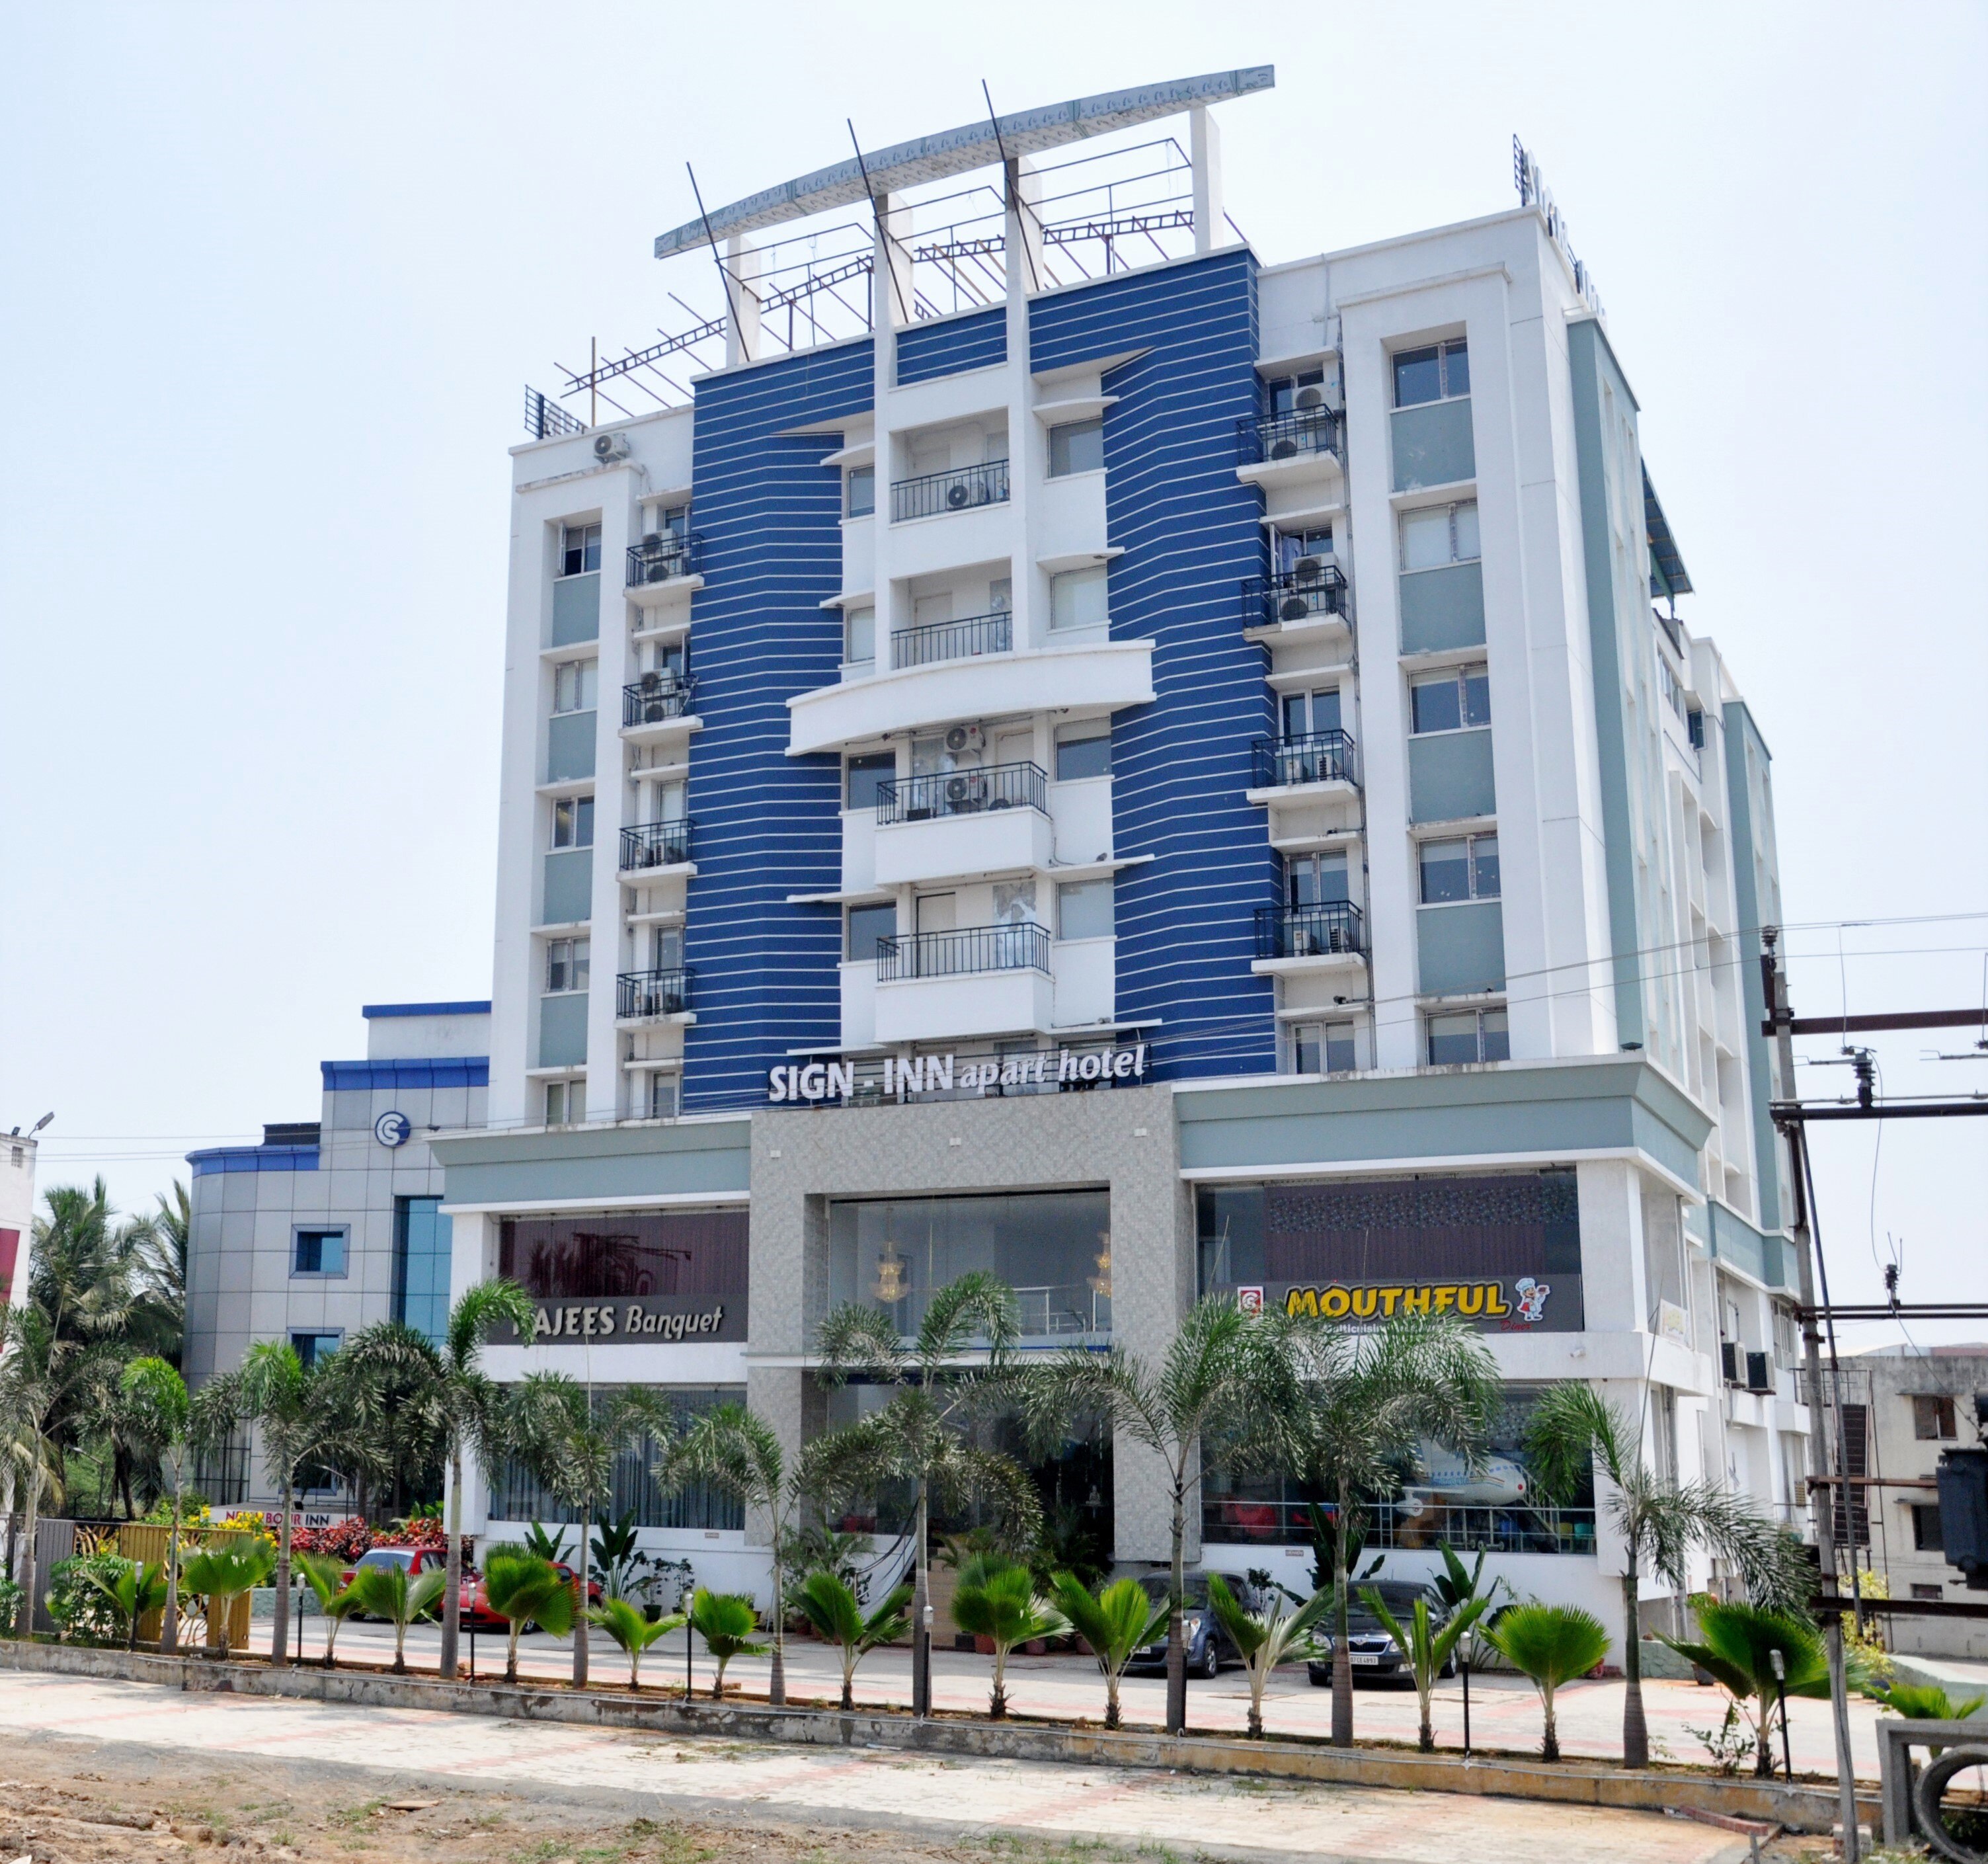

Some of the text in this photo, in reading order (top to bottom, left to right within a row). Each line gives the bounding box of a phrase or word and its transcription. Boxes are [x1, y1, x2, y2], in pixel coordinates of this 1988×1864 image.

[769, 1061, 854, 1102] SIGN
[884, 1054, 953, 1094] INN
[960, 1051, 1047, 1094] apart
[1058, 1044, 1145, 1082] hotel
[1287, 1285, 1507, 1317] MOUTHFUL
[512, 1305, 723, 1340] AJEES Banquet
[305, 1514, 329, 1525] INN
